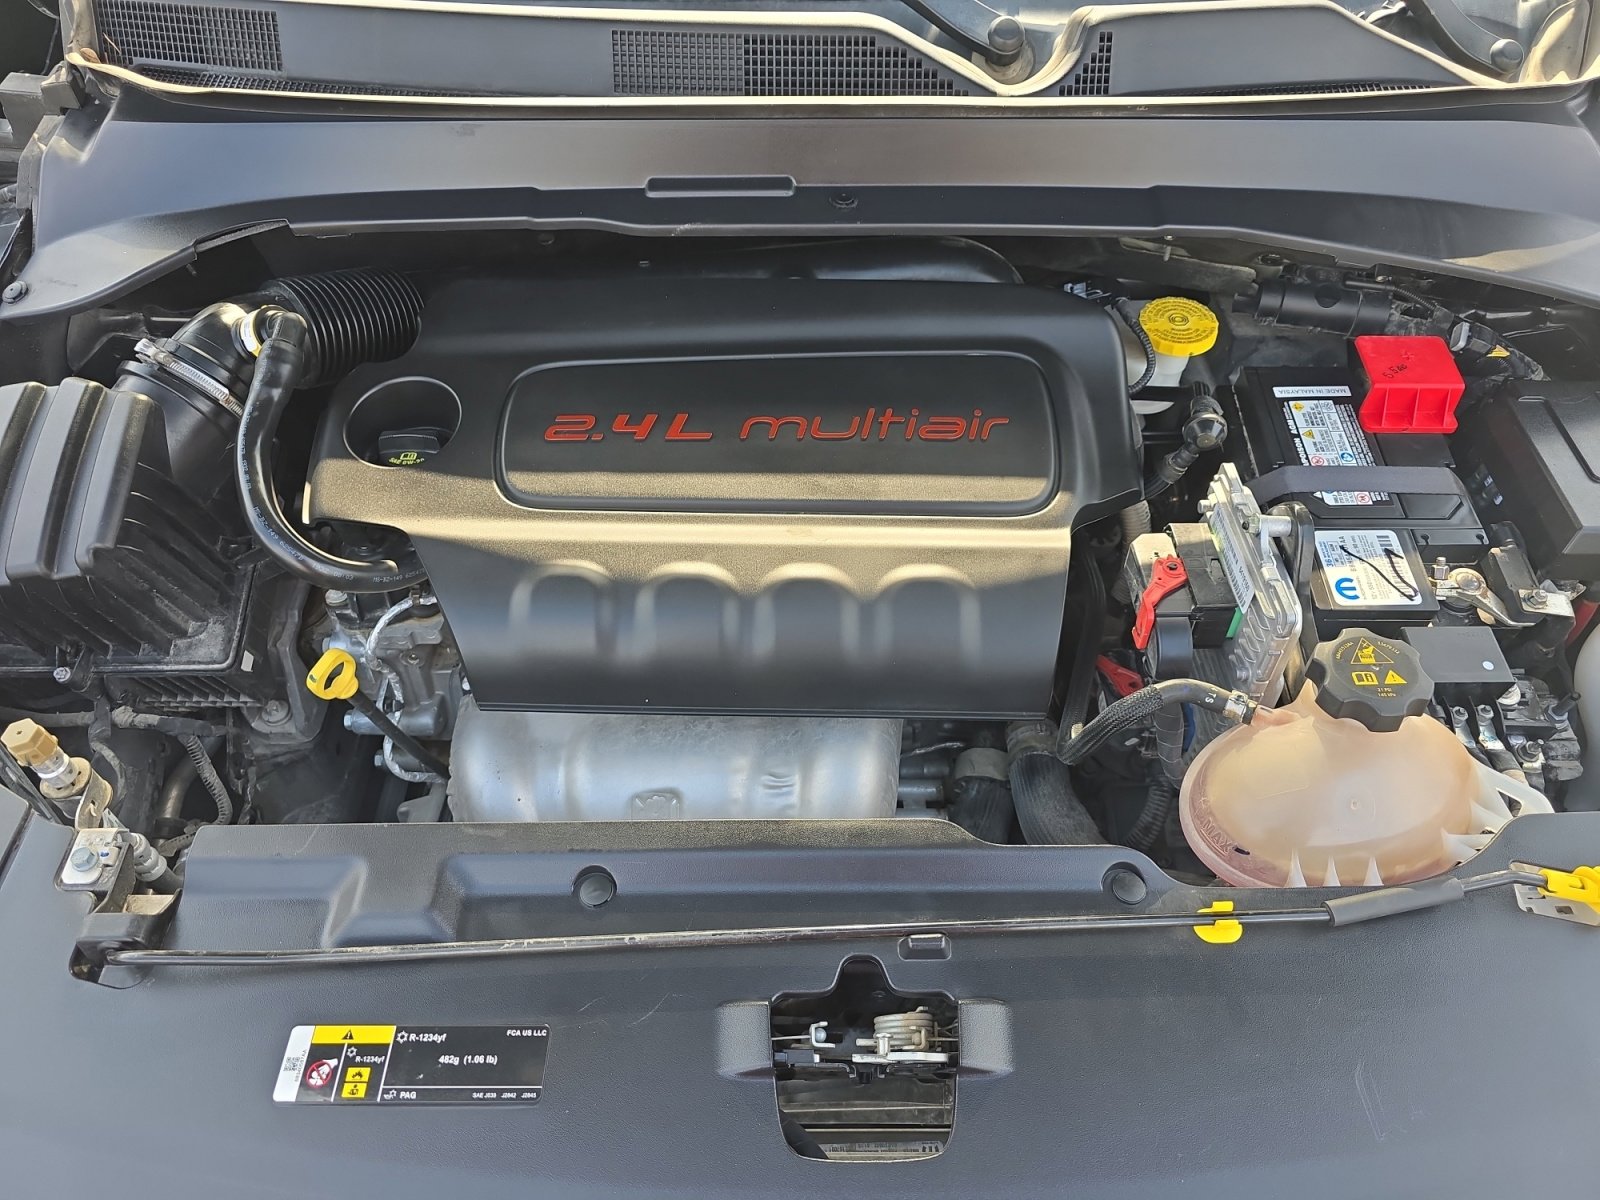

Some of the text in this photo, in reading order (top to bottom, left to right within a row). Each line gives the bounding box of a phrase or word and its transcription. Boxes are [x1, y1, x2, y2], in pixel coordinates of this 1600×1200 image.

[739, 407, 1009, 441] multiair
[1286, 419, 1299, 434] AGM
[1201, 818, 1232, 855] MAX
[409, 1032, 447, 1043] R-1234yf
[506, 1029, 547, 1037] FCA US LLC
[355, 1055, 386, 1064] R-1234yf
[438, 1055, 460, 1066] 482g
[485, 1055, 498, 1066] lb)
[399, 1091, 417, 1100] PAG
